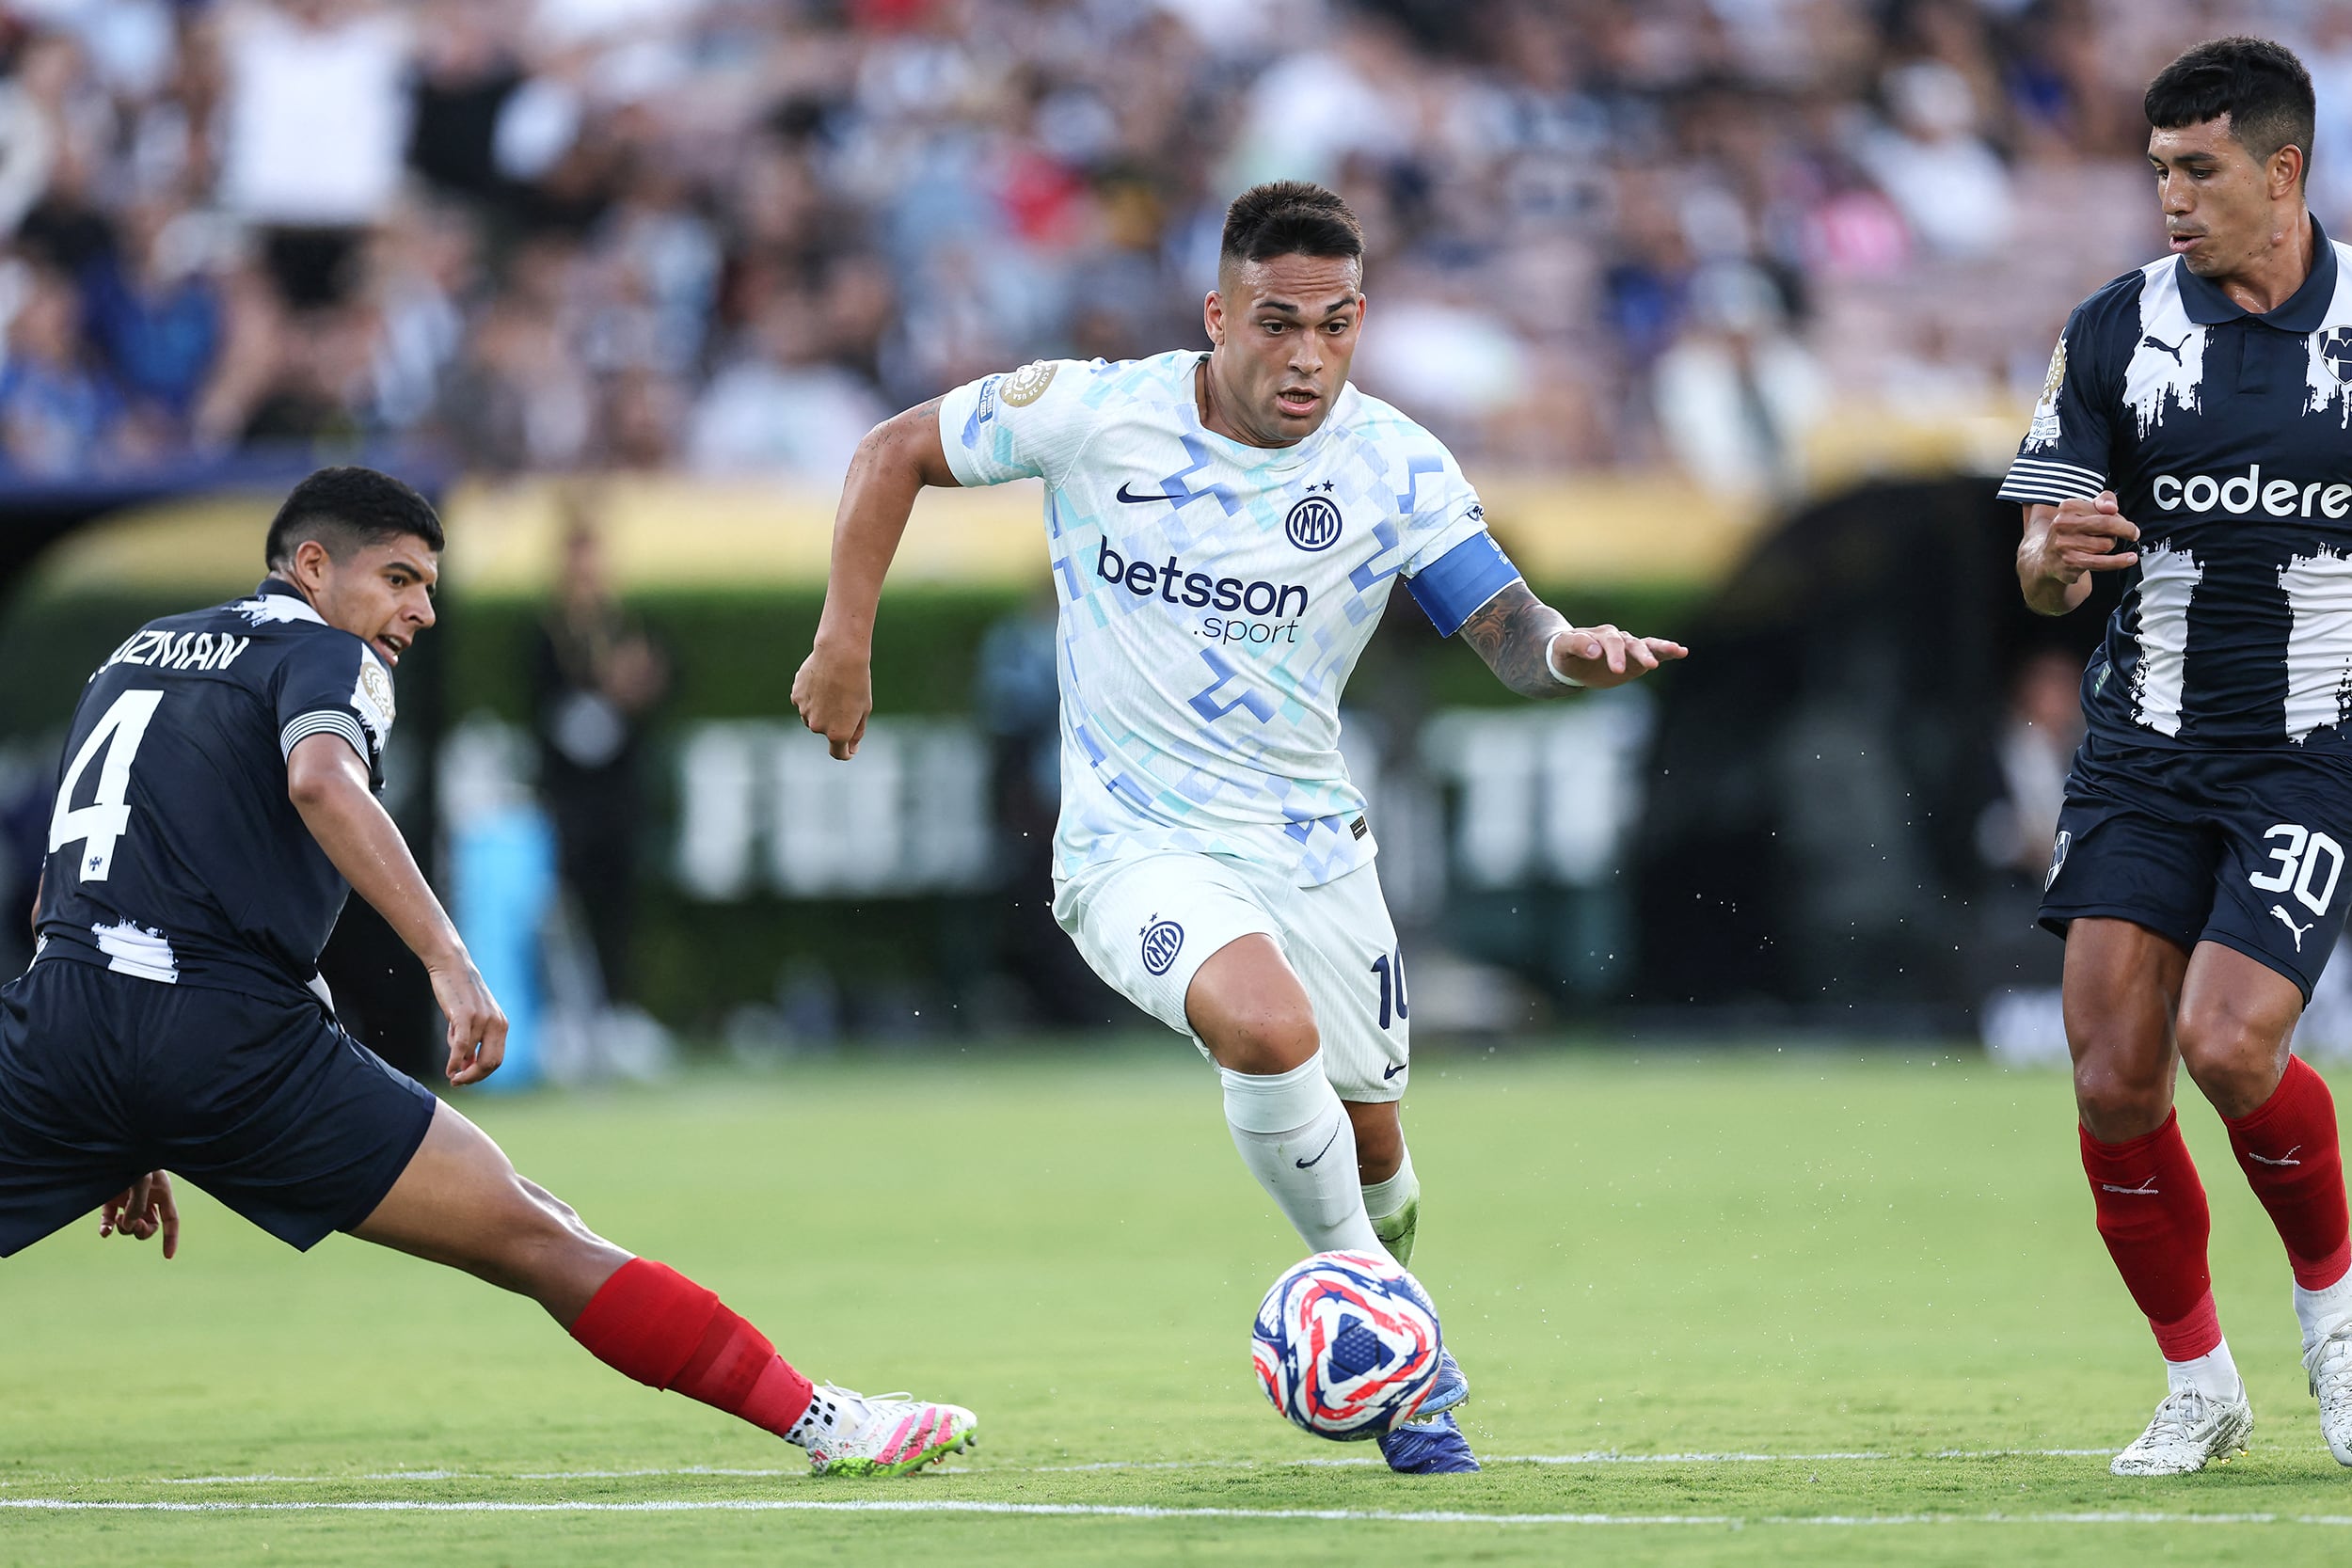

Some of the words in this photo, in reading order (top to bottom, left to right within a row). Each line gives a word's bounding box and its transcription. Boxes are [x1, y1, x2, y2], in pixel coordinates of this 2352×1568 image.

[2153, 464, 2352, 518] codere
[1096, 533, 1309, 617] betsson
[88, 629, 250, 684] UZMAN
[1193, 617, 1298, 644] .sport
[49, 689, 165, 883] 4
[2248, 823, 2345, 916] 30
